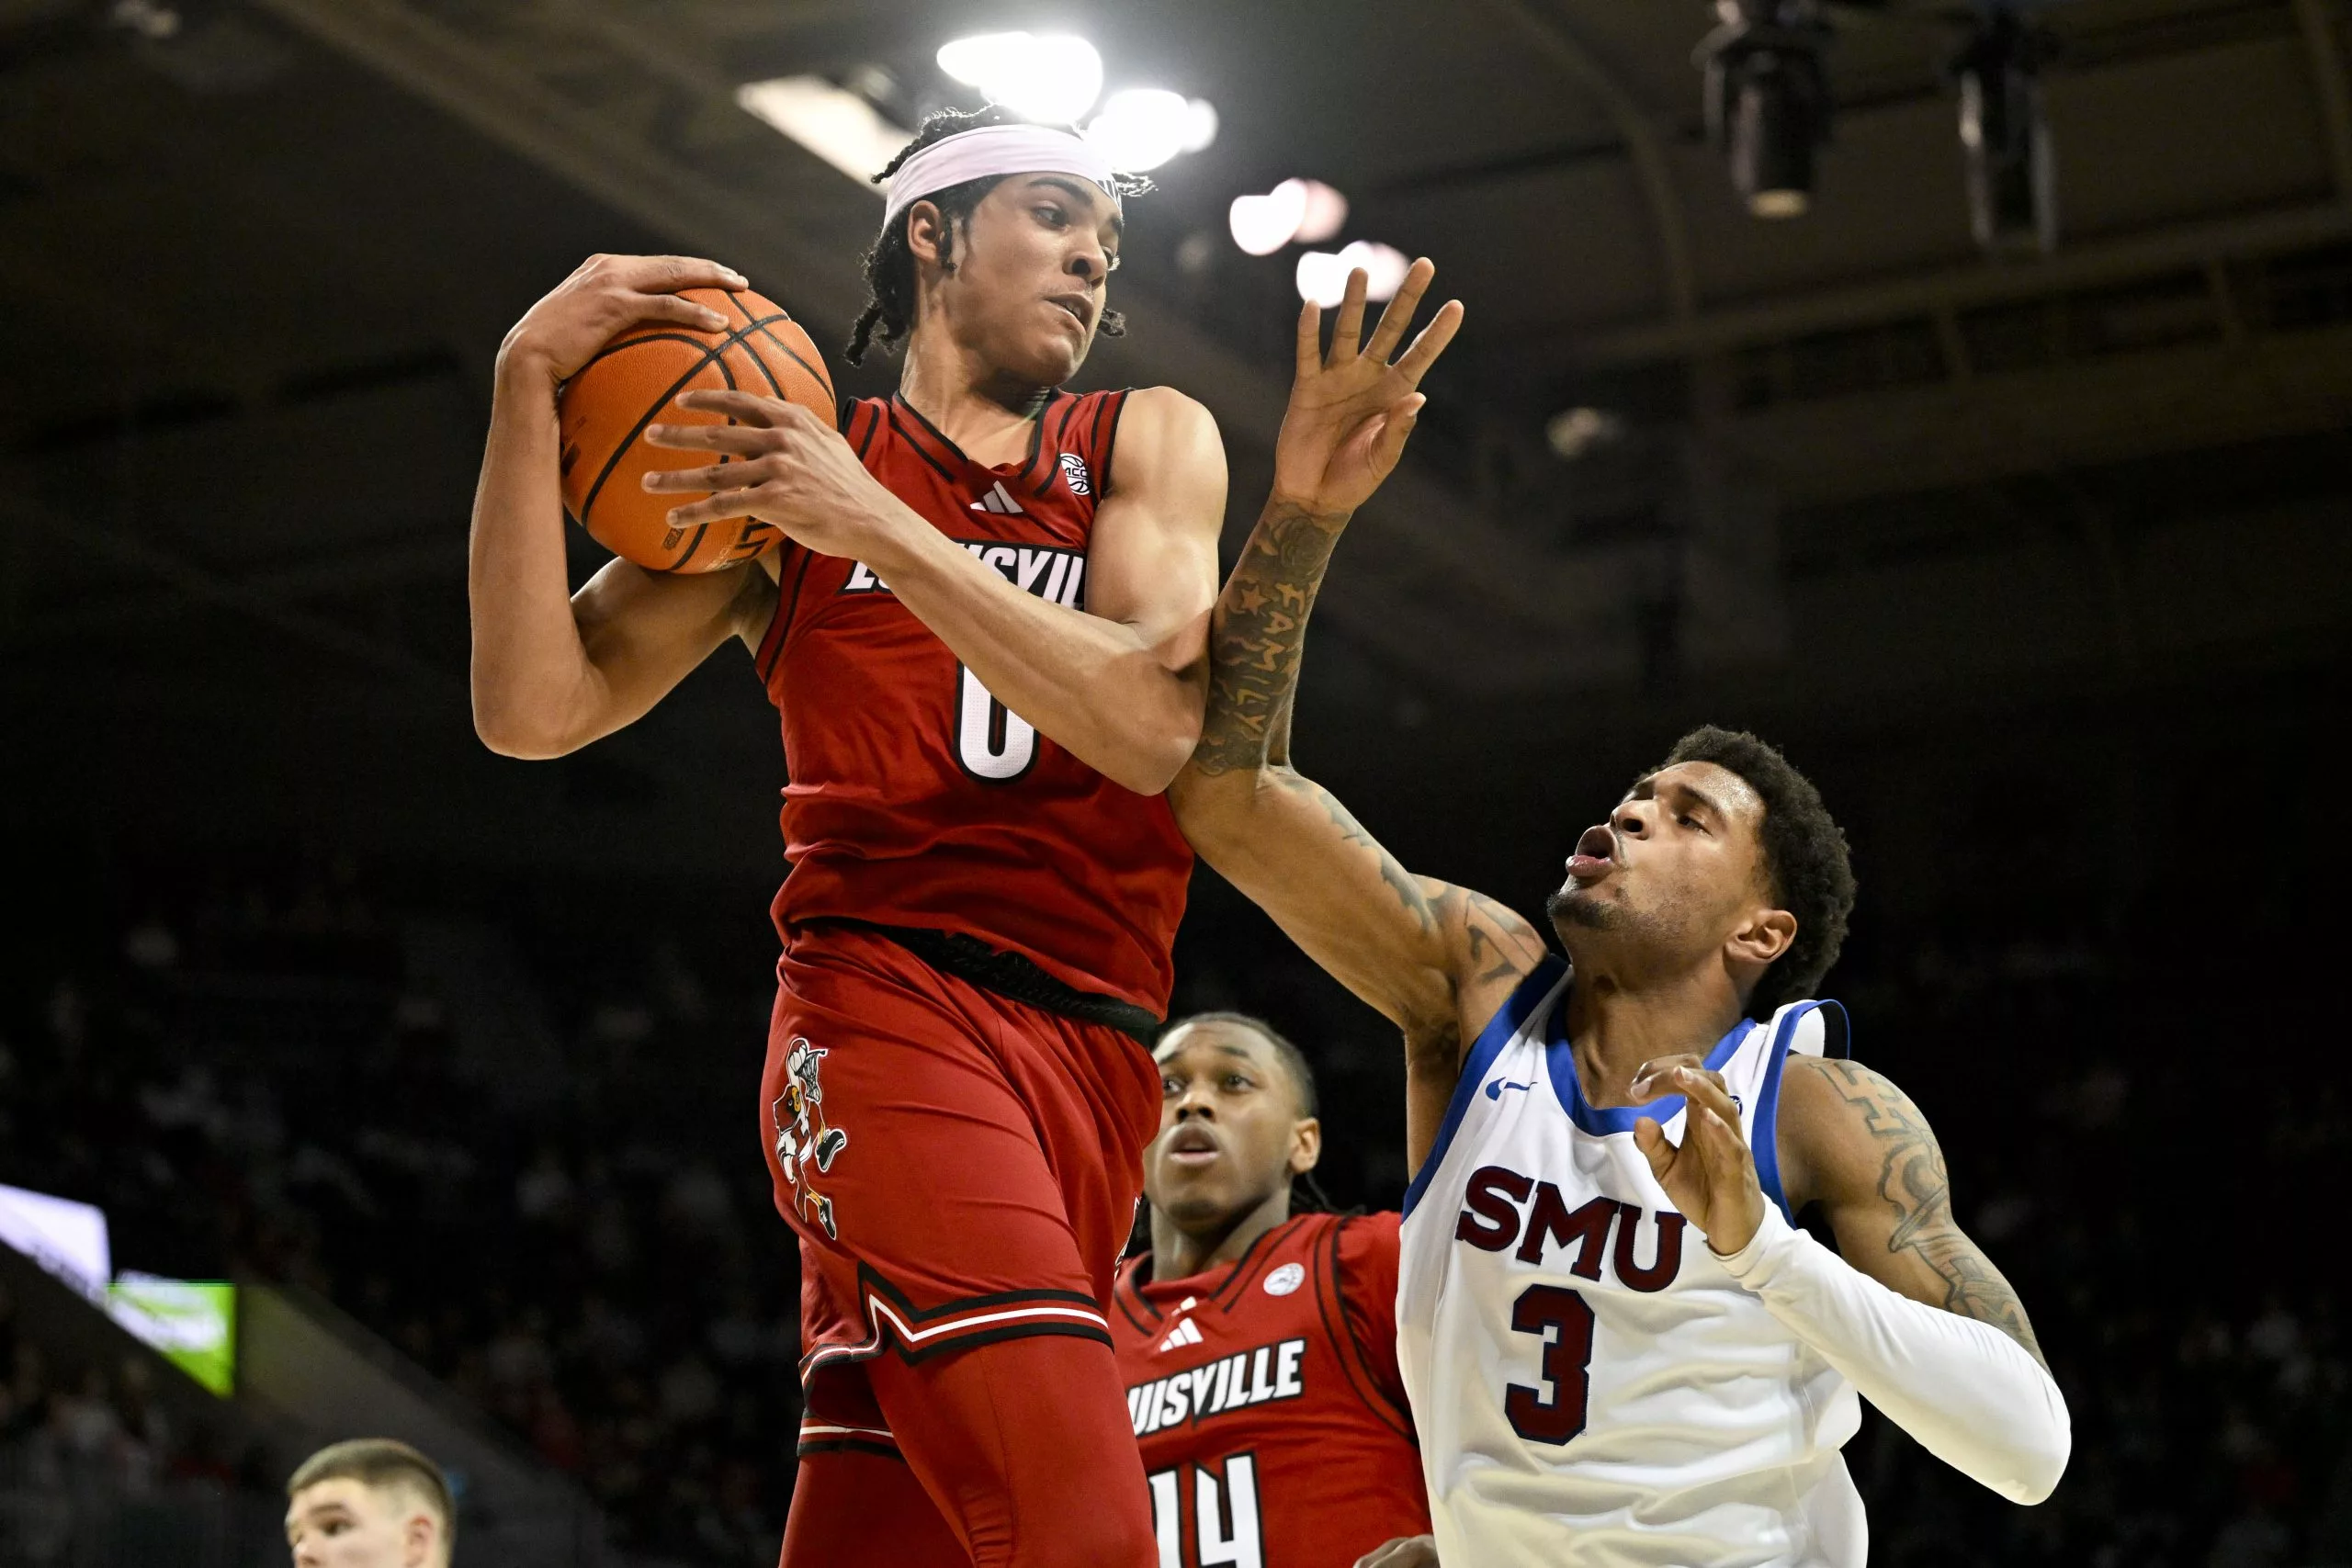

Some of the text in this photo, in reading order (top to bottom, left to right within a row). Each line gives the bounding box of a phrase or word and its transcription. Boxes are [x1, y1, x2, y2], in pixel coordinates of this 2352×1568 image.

[1232, 582, 1306, 733] FAMILY
[1455, 1165, 1688, 1293] SMU
[1504, 1282, 1596, 1447] 3
[1148, 1453, 1263, 1568] 14
